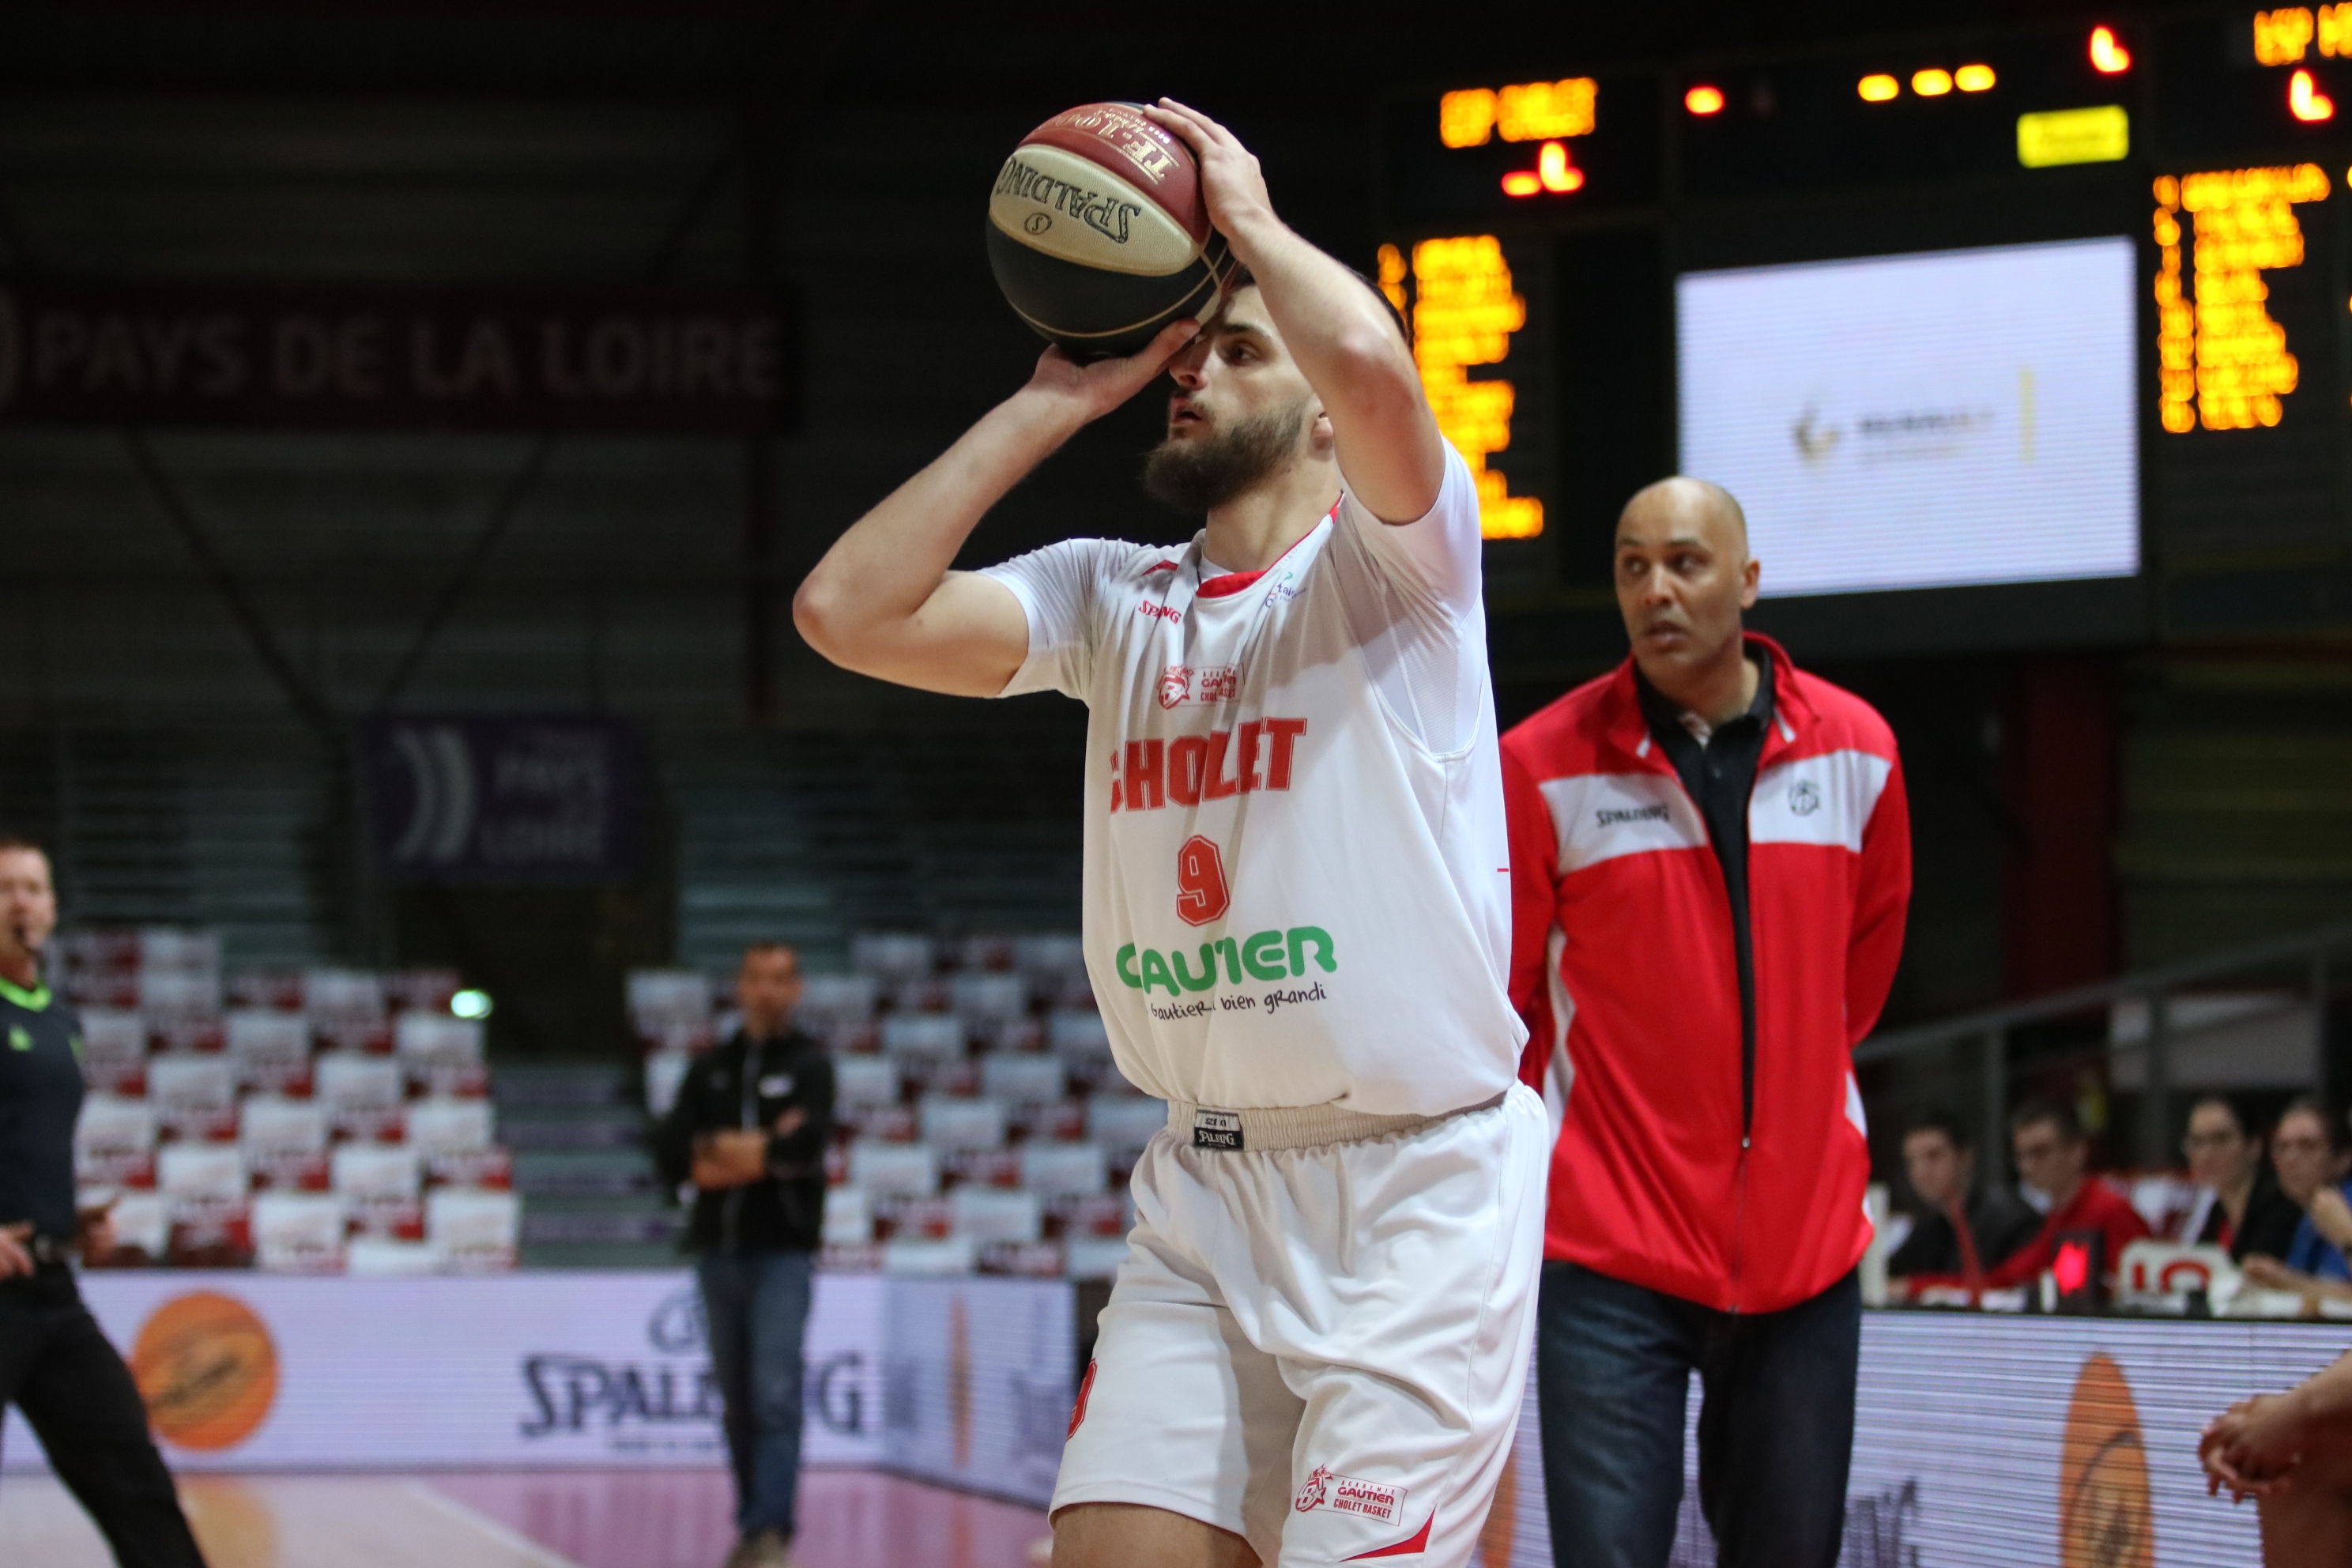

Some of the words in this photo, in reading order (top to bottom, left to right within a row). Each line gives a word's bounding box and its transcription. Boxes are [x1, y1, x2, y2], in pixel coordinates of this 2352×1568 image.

[996, 156, 1141, 244] SPALDING
[32, 312, 248, 398] PAYS
[273, 314, 384, 398] DE
[410, 315, 518, 398] LA
[541, 316, 779, 398] LOIRE
[1176, 835, 1231, 928] 9
[1220, 993, 1257, 1012] bien
[1333, 1498, 1363, 1513] CHOLET
[1363, 1504, 1393, 1520] BASKET
[1337, 1487, 1394, 1506] GAUTIER
